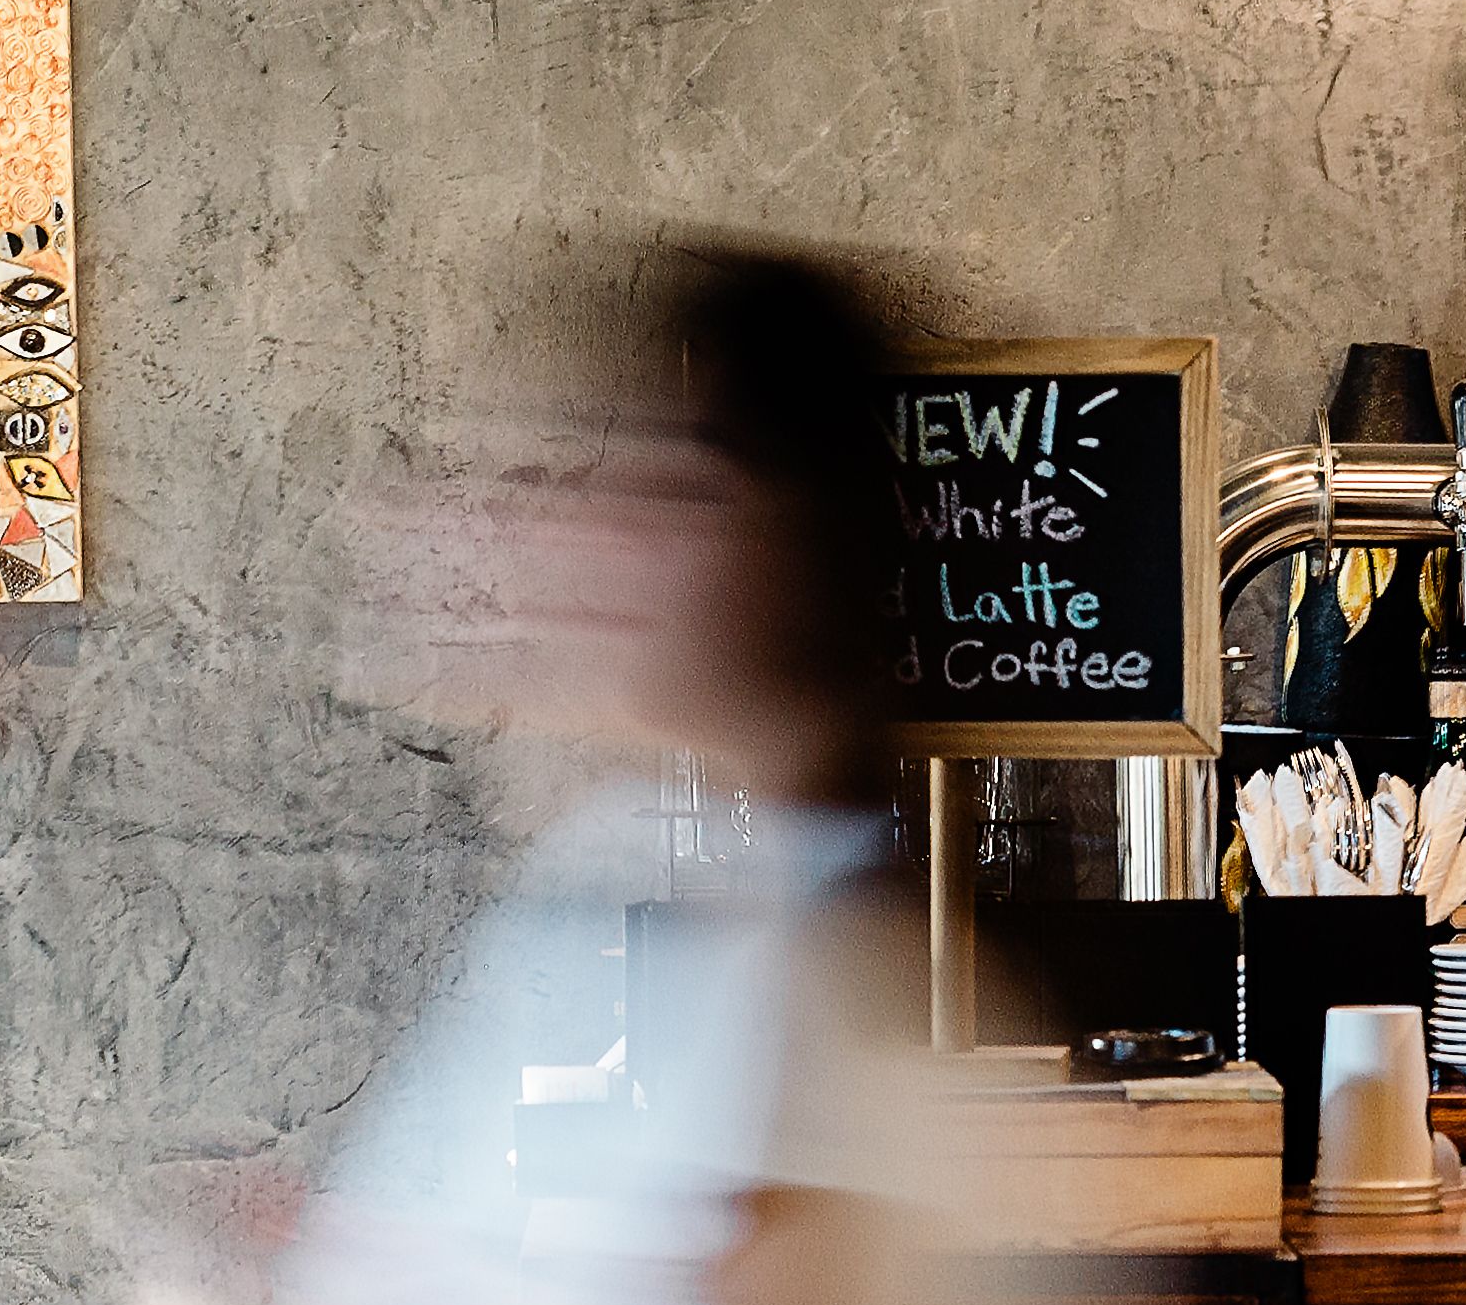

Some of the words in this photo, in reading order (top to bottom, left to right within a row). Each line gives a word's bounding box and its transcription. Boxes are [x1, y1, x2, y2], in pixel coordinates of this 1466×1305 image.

[894, 479, 1086, 542] White
[940, 562, 1100, 629] Latte
[944, 638, 1153, 691] Coffee
